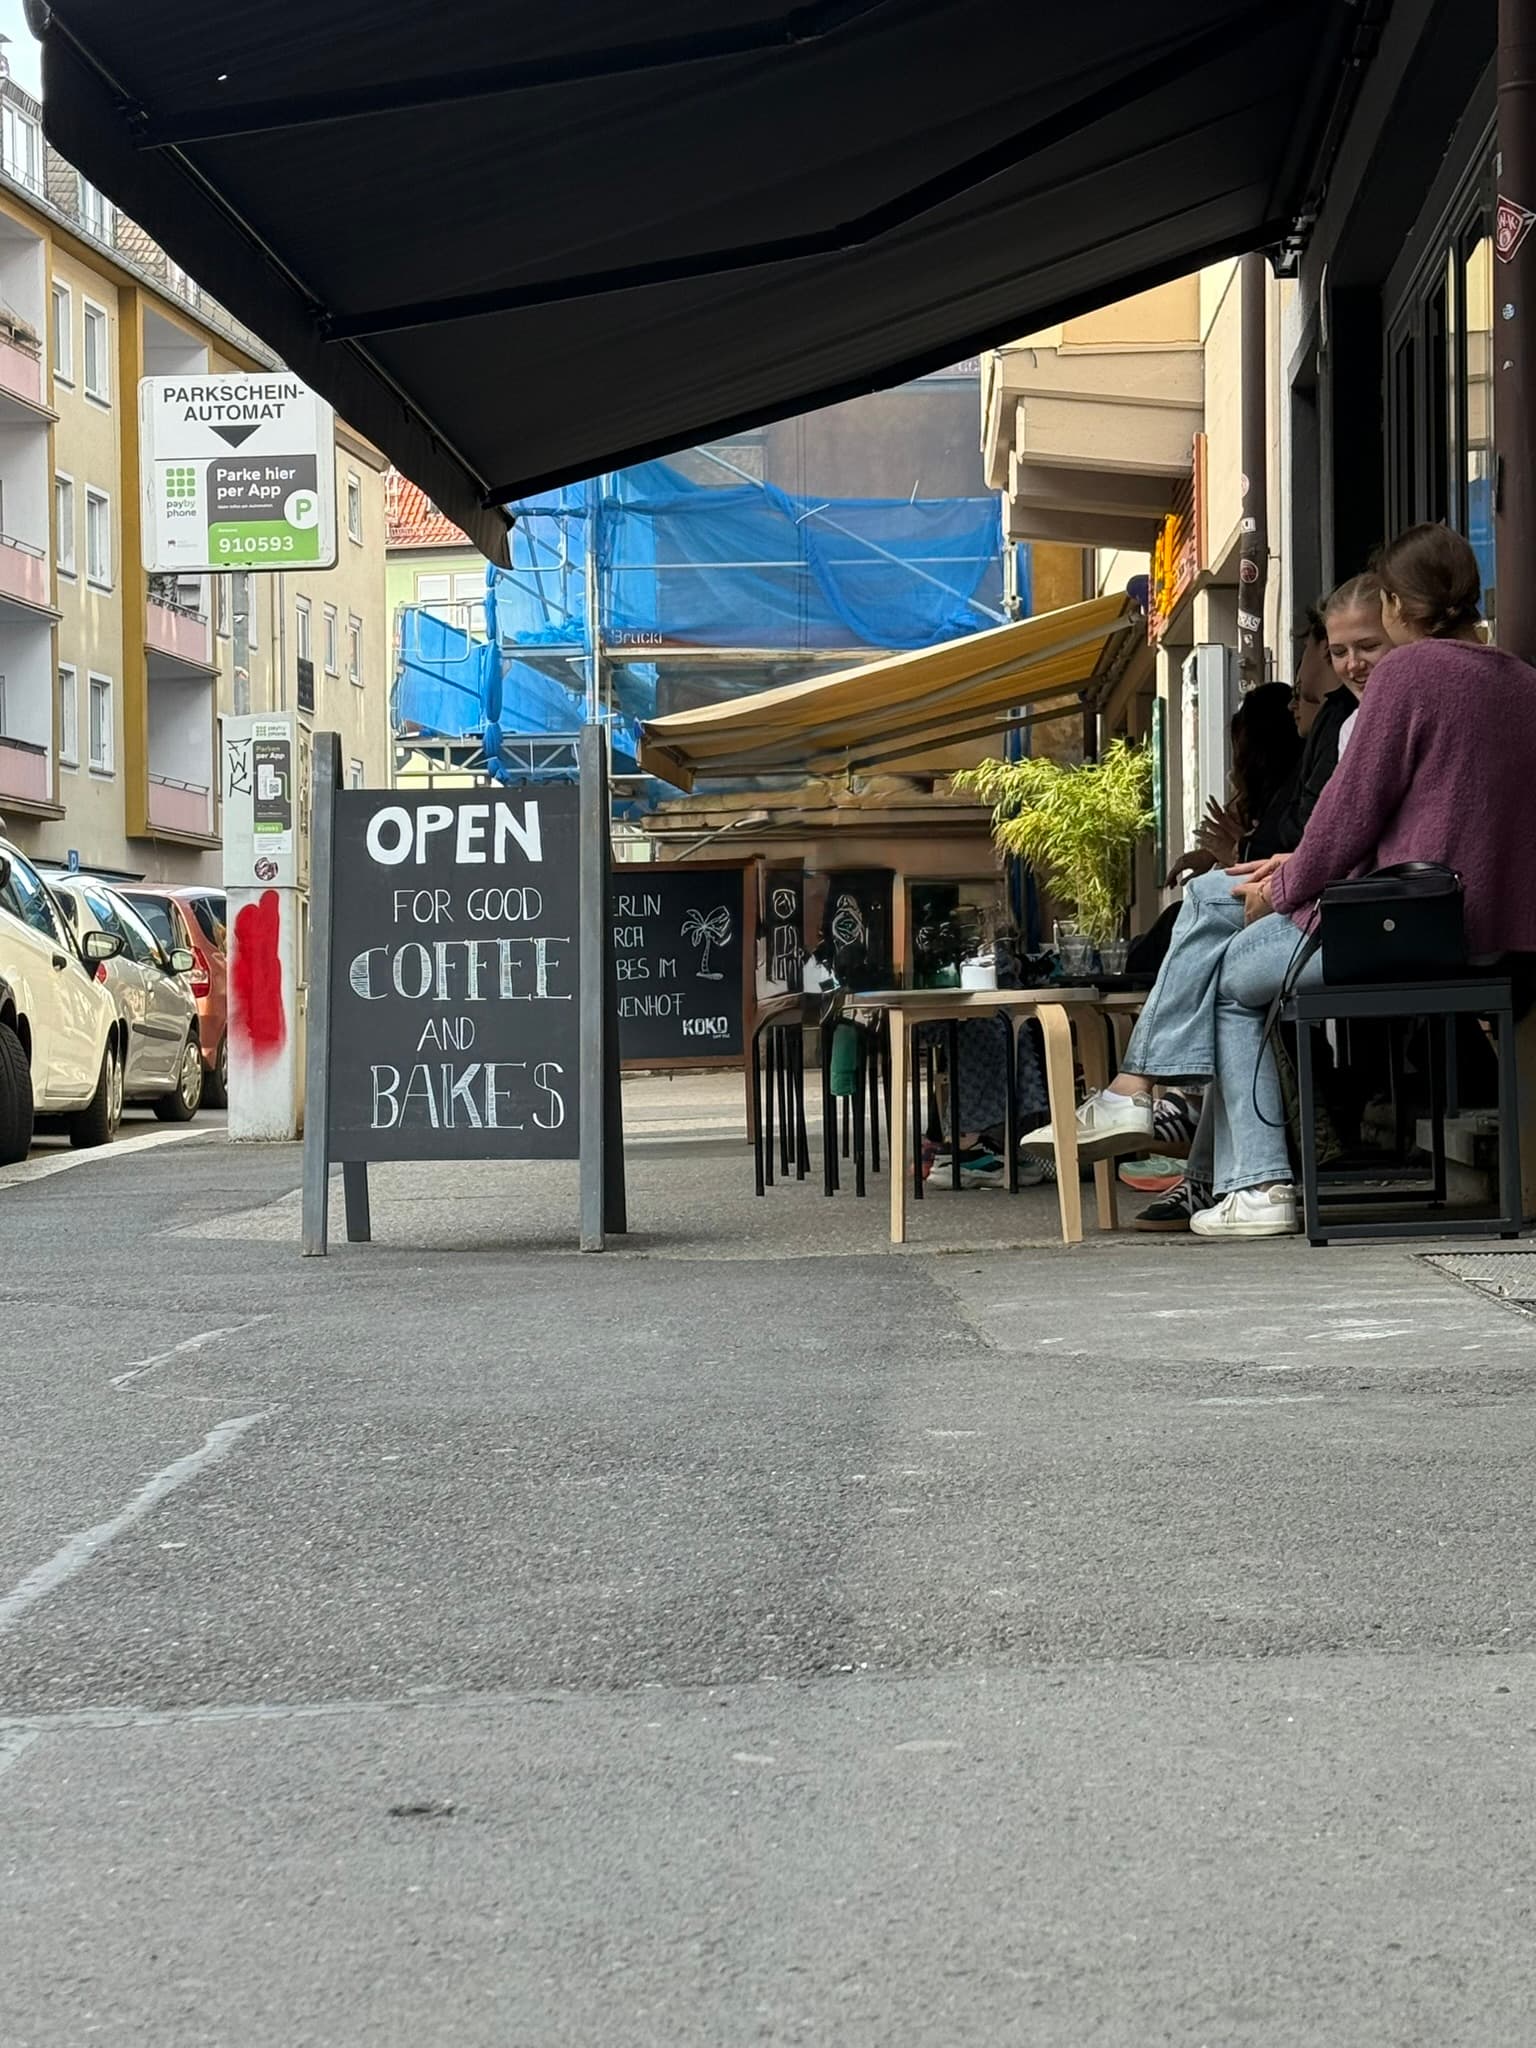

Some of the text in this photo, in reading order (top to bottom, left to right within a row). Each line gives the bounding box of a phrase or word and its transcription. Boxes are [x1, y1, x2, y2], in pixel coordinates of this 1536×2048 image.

[163, 384, 305, 403] PARKSCHEIN-
[184, 404, 285, 421] AUTOMAT
[217, 468, 296, 482] Parke hier
[217, 484, 281, 500] per App
[167, 508, 197, 518] phone
[219, 536, 294, 553] 910593
[366, 800, 543, 864] OPEN
[394, 887, 543, 923] FOR GOOD
[350, 937, 572, 1001] COFFEE
[659, 958, 676, 978] IM
[416, 1017, 476, 1051] AND
[683, 1016, 728, 1036] KOKO
[370, 1062, 565, 1130] BAKES
